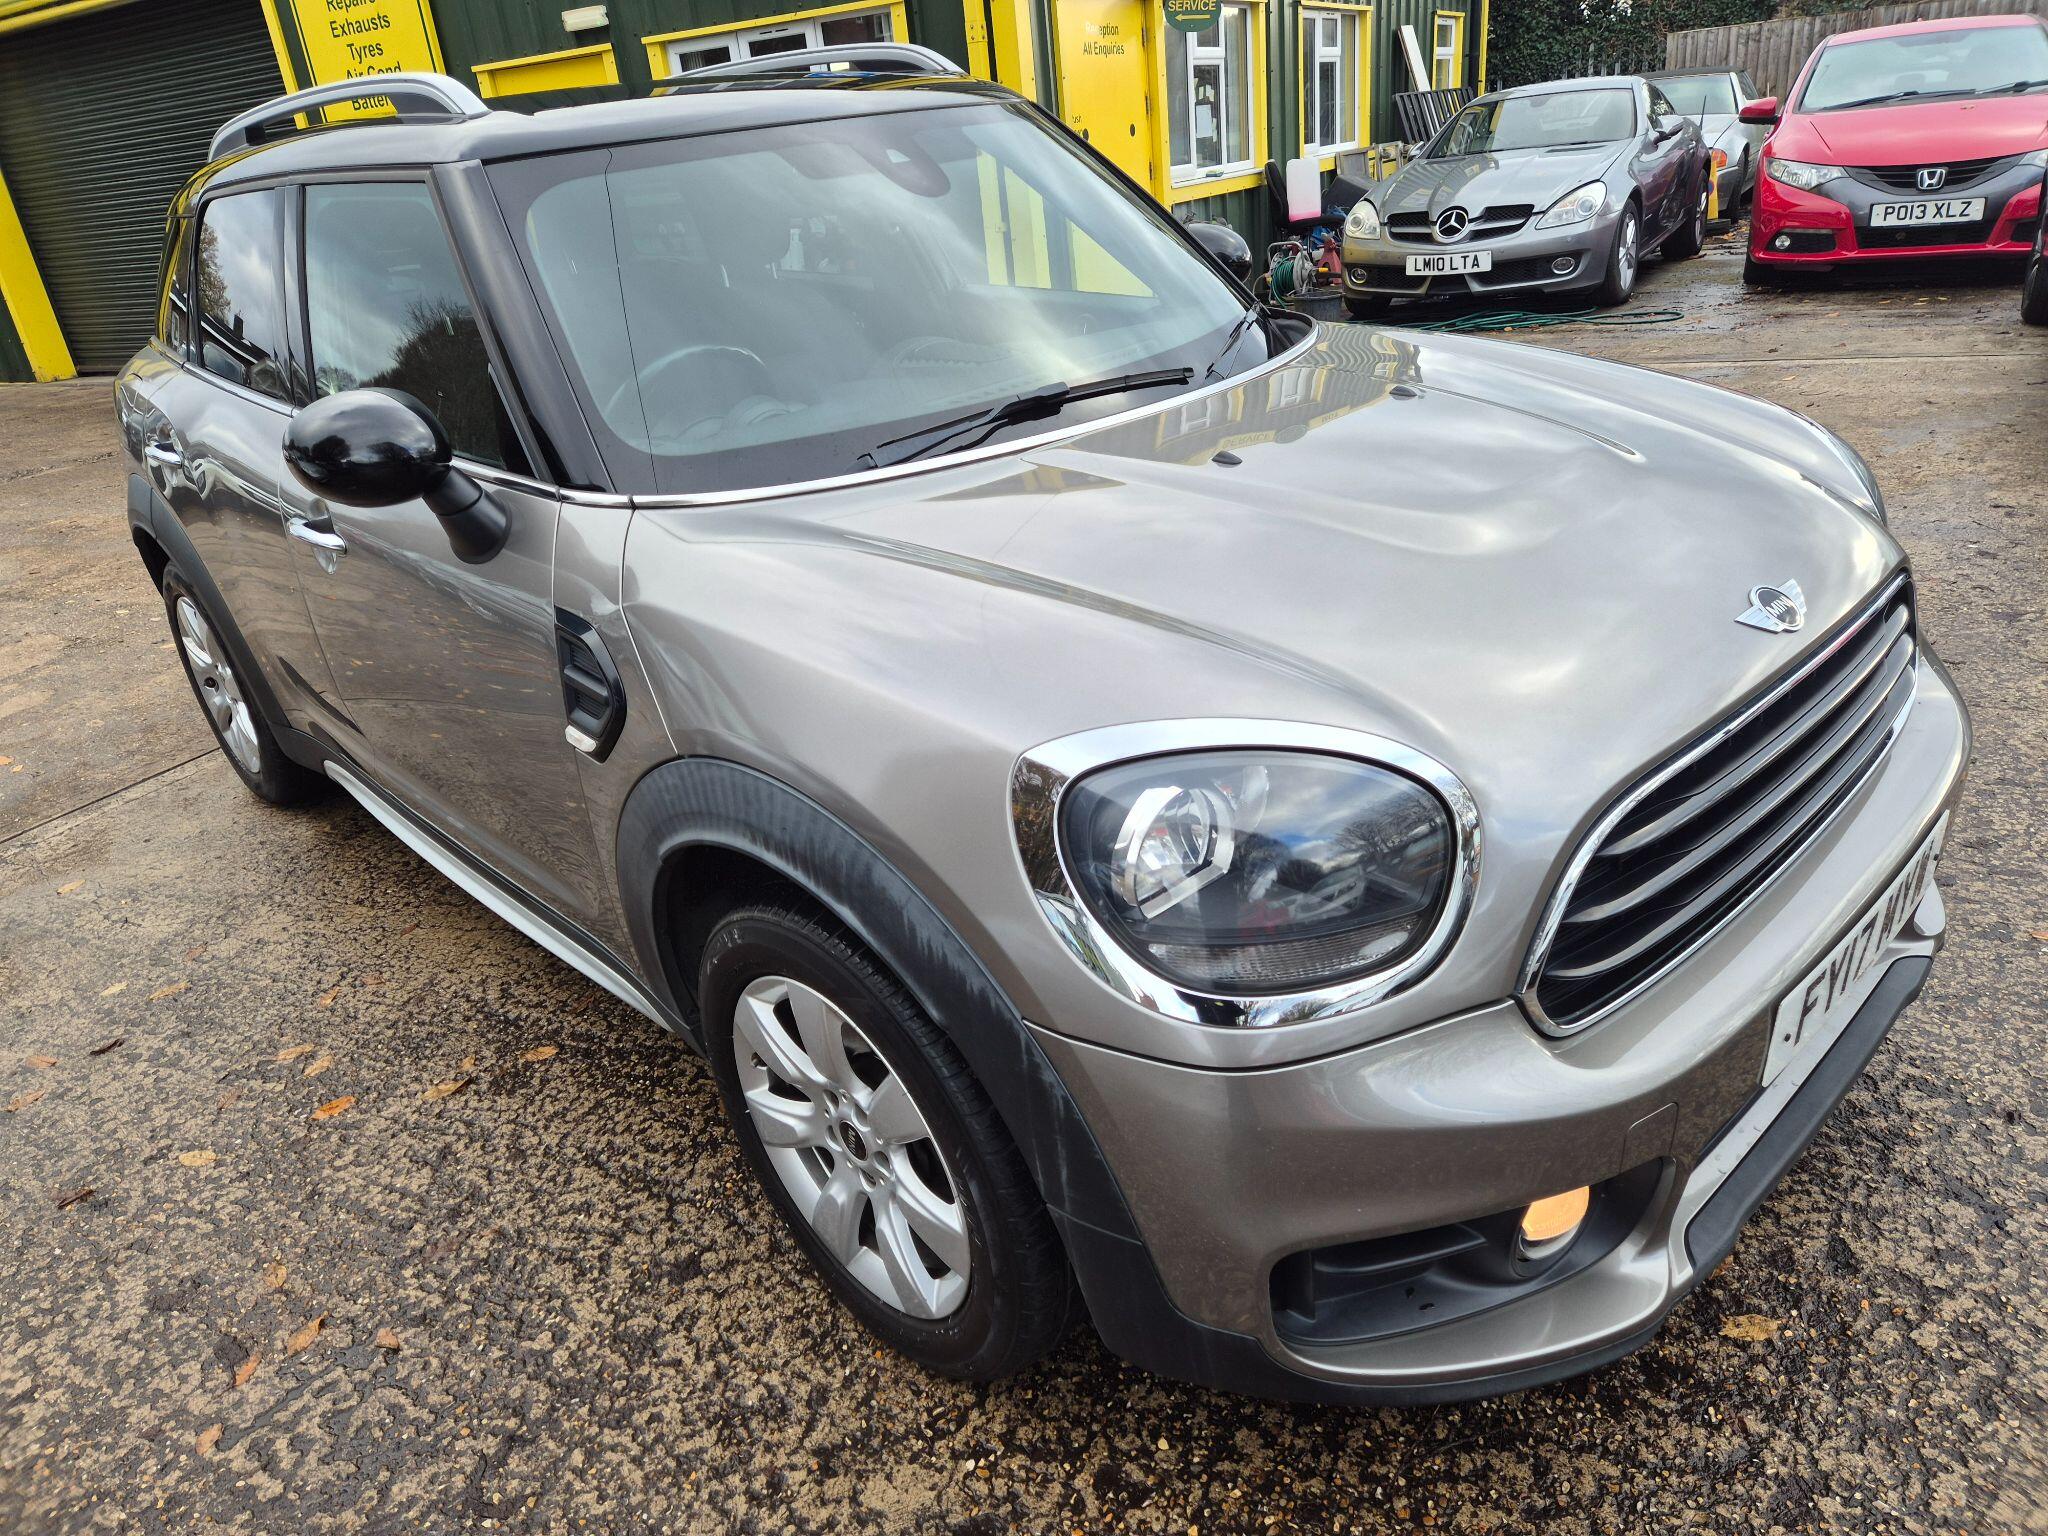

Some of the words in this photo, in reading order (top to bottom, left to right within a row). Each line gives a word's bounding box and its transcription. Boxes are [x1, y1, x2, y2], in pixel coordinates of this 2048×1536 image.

[326, 0, 376, 13] Repa
[1168, 0, 1217, 11] SERVICE
[330, 12, 391, 38] Exhausts
[346, 42, 384, 64] Tyres
[1083, 41, 1093, 55] All
[1093, 41, 1125, 58] Enquiries
[1883, 203, 1927, 221] PO13
[1932, 201, 1972, 218] XLZ
[1414, 257, 1445, 272] LM10
[1449, 254, 1480, 271] LTA
[1794, 910, 1879, 1047] FY17
